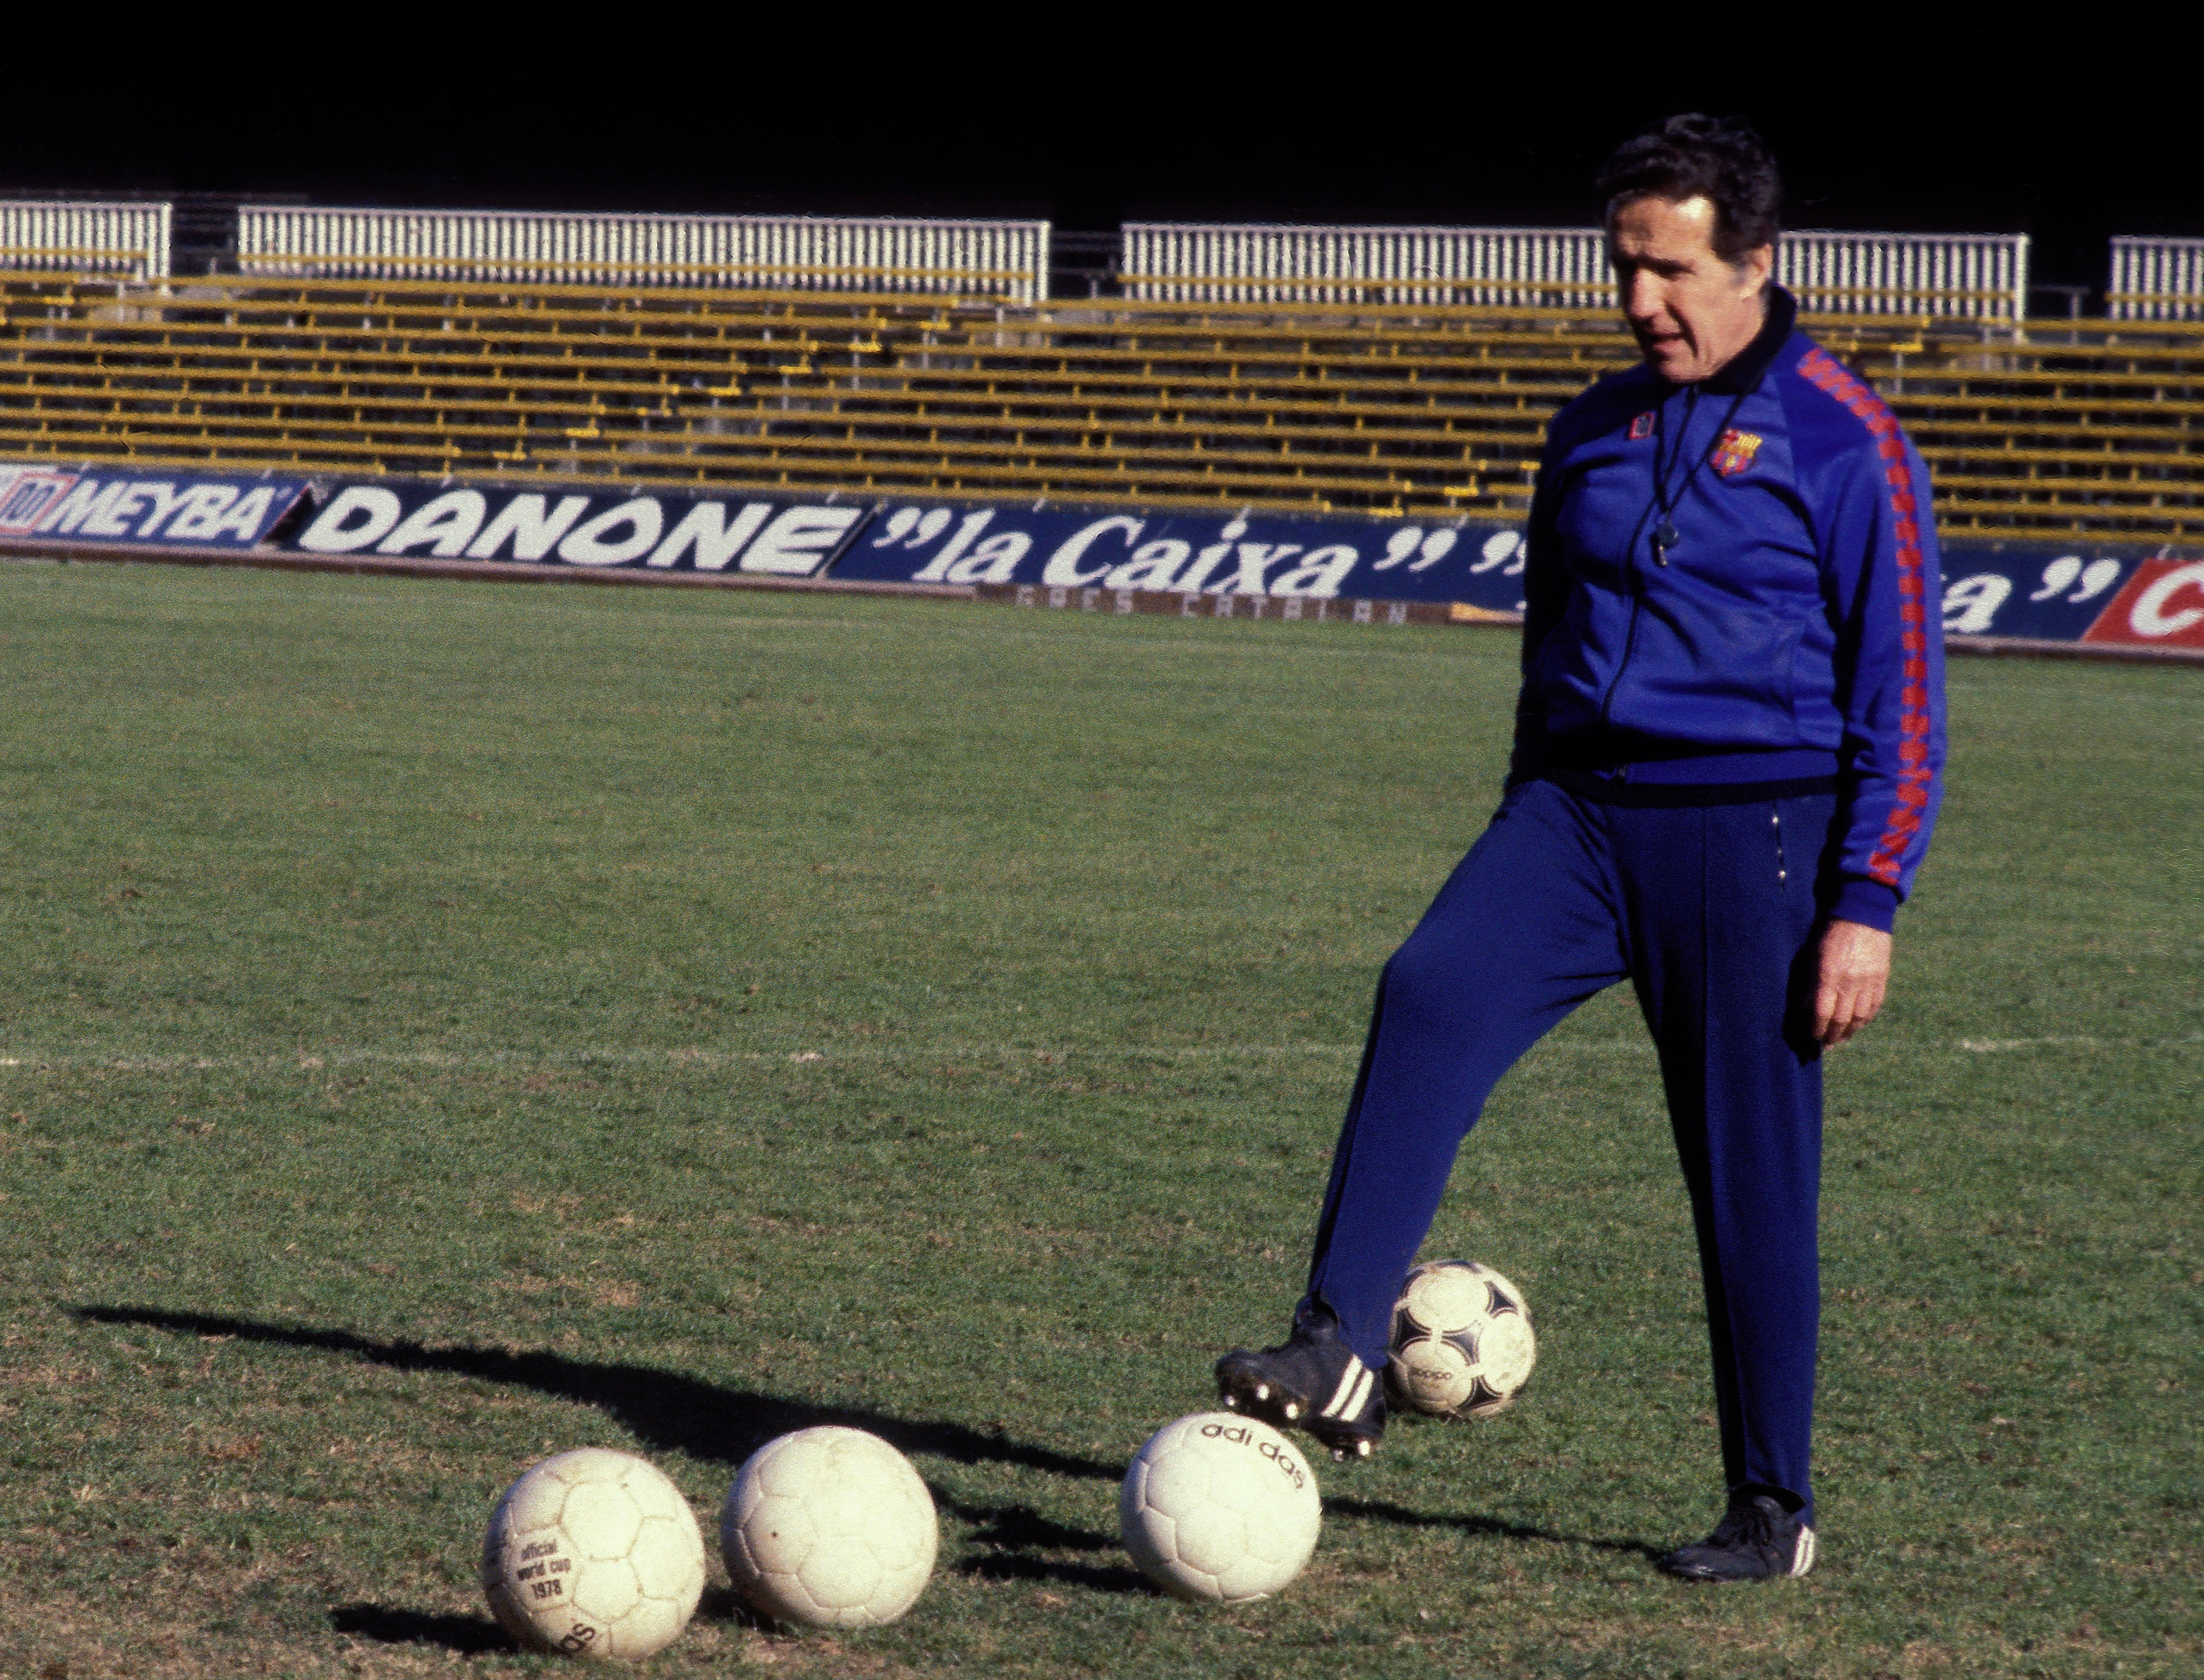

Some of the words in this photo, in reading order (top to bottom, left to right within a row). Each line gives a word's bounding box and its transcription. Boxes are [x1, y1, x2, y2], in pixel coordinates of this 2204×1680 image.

[33, 479, 277, 541] MEYBA
[299, 486, 862, 575] DANONE
[549, 1558, 572, 1574] cup
[531, 1579, 563, 1600] 1978
